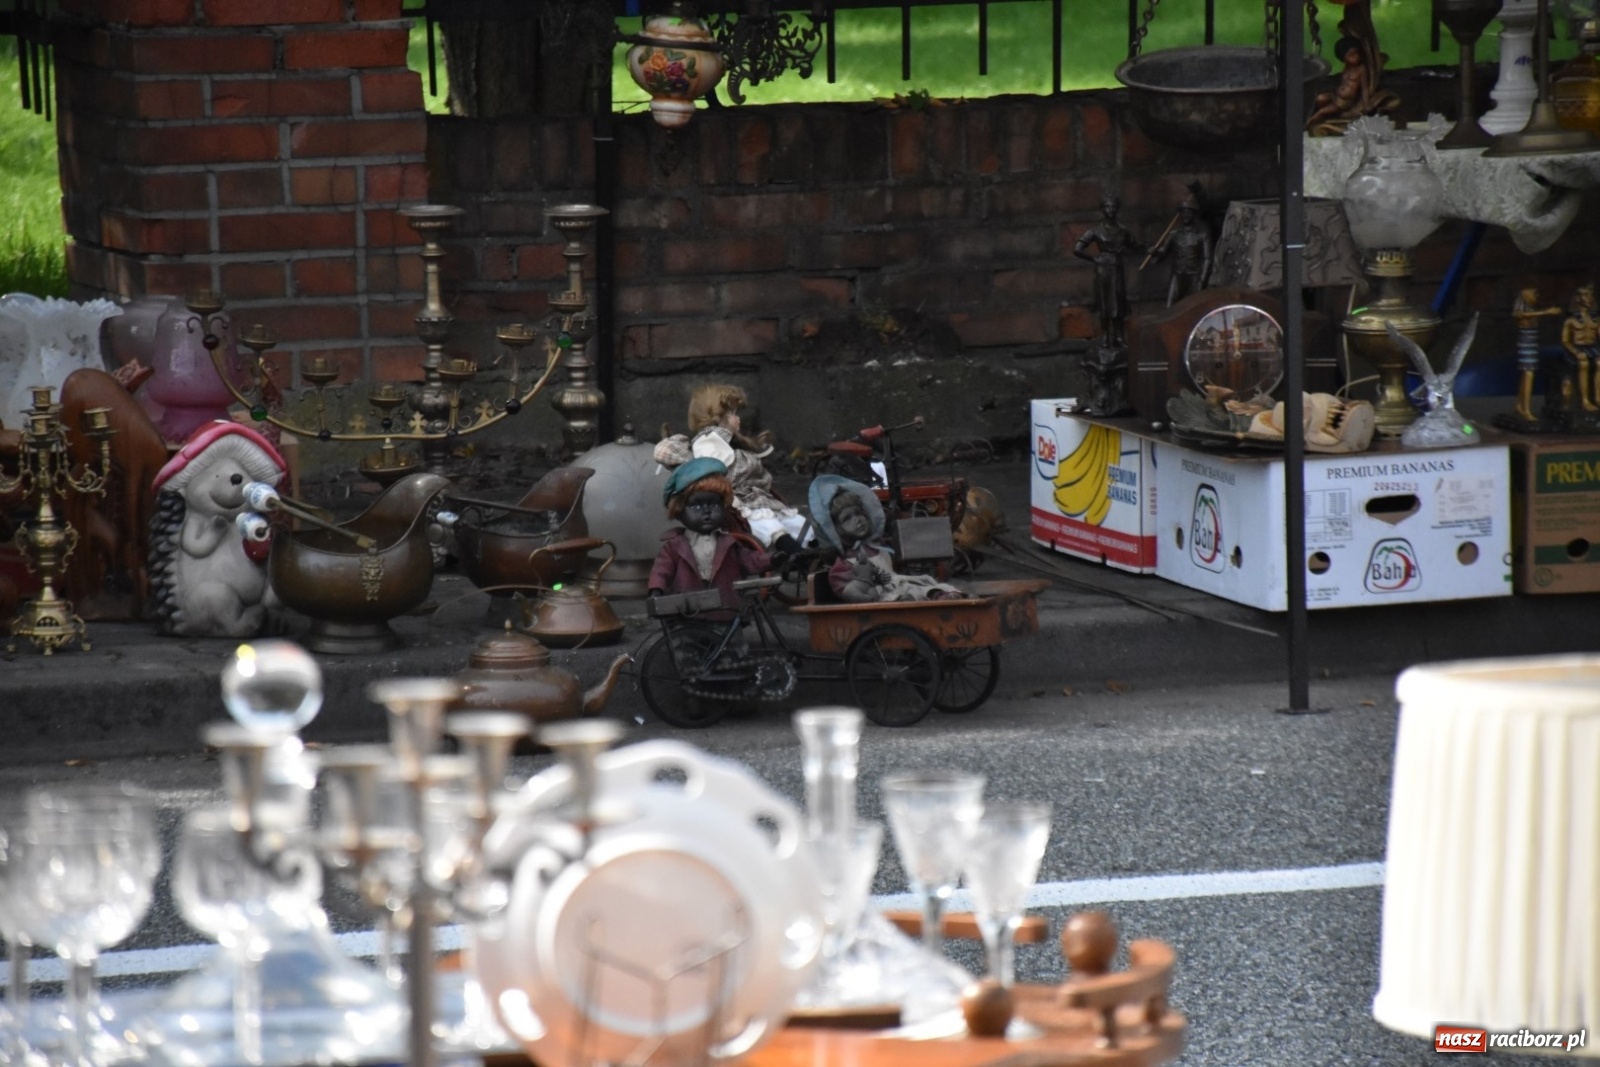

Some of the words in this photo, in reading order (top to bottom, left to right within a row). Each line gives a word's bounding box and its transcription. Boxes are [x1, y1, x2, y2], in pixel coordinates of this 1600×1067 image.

[1038, 435, 1057, 461] Dole
[1108, 465, 1137, 487] PREMIUM
[1182, 459, 1208, 477] PREMIUM
[1209, 467, 1237, 486] BANANAS
[1326, 464, 1388, 480] PREMIUM
[1391, 460, 1455, 476] BANANAS
[1546, 461, 1600, 484] PREM
[1107, 484, 1138, 506] BANANAS
